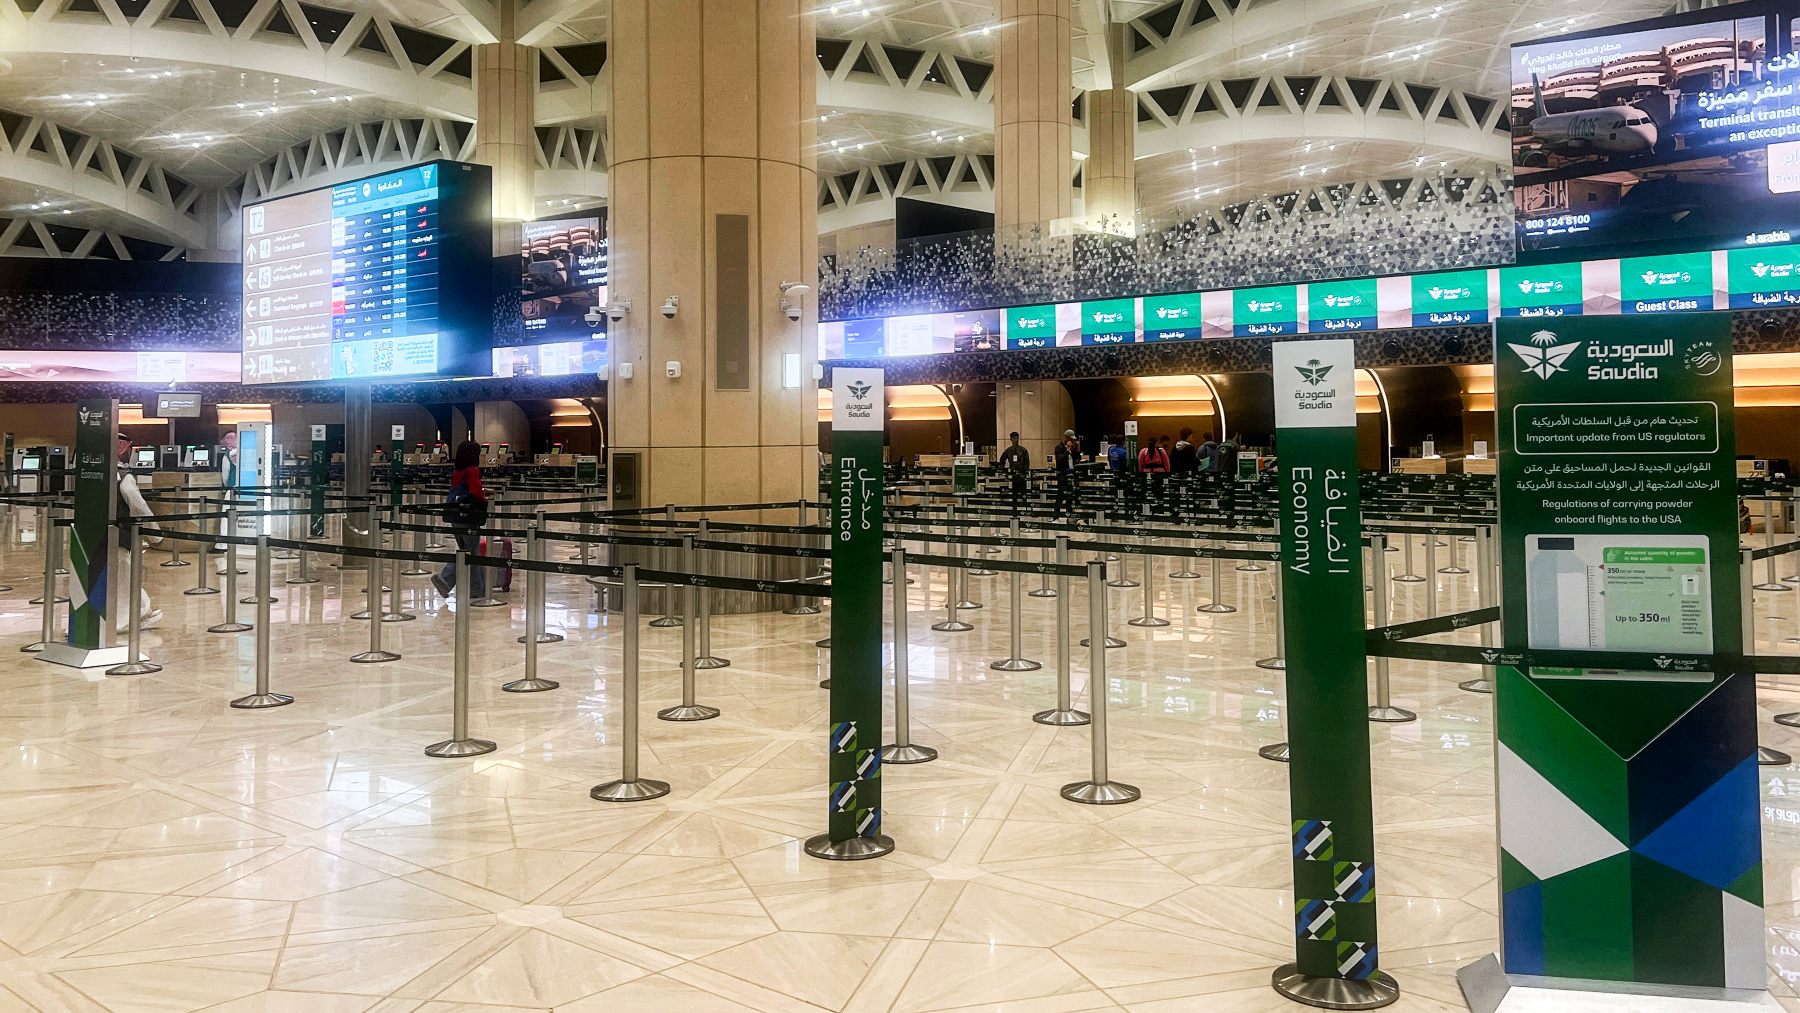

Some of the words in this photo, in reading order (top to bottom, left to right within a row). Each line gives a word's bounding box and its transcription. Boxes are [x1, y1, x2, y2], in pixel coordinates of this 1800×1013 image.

[1575, 46, 1599, 56] الملك
[1600, 43, 1621, 53] مطار
[1556, 50, 1574, 59] خالد
[1752, 80, 1793, 105] سفر
[1698, 90, 1749, 111] مميزة
[1698, 111, 1756, 129] Terminal
[1729, 131, 1746, 142] an
[251, 211, 263, 230] T2
[1525, 219, 1544, 229] 800
[1546, 216, 1564, 227] 124
[1565, 214, 1591, 225] 8100
[1745, 232, 1756, 245] al
[1757, 230, 1791, 244] arabia
[1635, 301, 1667, 312] Guest
[1668, 299, 1698, 310] Class
[1586, 338, 1674, 363] السعودية
[1587, 364, 1658, 381] Saudia
[1294, 388, 1336, 402] السعودية
[845, 402, 873, 411] السعودية
[1298, 400, 1333, 410] Saudia
[1531, 414, 1570, 428] الأمريكية
[1572, 416, 1612, 426] السلطات
[1614, 415, 1632, 427] قبل
[1633, 418, 1648, 427] من
[1649, 416, 1667, 428] هام
[1668, 415, 1699, 427] تحديث
[1526, 433, 1574, 443] Important
[1576, 432, 1610, 443] update
[1612, 432, 1636, 441] from
[1637, 432, 1652, 441] US
[1654, 432, 1706, 443] regulators
[1523, 464, 1543, 474] متن
[1544, 463, 1562, 474] على
[1562, 463, 1608, 474] المساحيق
[1609, 463, 1637, 474] لحمل
[1638, 462, 1672, 473] الجديدة
[1673, 462, 1711, 474] القوانين
[81, 468, 104, 480] Economy
[1516, 477, 1555, 491] الأمريكية
[1556, 480, 1593, 490] المتحدة
[1595, 480, 1628, 491] الولايات
[1629, 480, 1644, 492] إلى
[1646, 480, 1683, 492] المتجهة
[1685, 480, 1720, 491] الرحلات
[840, 457, 856, 542] Entrance
[858, 468, 877, 530] مدخل
[1542, 499, 1599, 510] Regulations
[1600, 498, 1610, 508] of
[1612, 499, 1654, 510] carrying
[1655, 499, 1693, 510] powder
[1290, 466, 1313, 575] Economy
[1320, 468, 1350, 574] الضيافة
[1554, 514, 1596, 524] onboard
[1597, 514, 1628, 525] flights
[1629, 515, 1639, 524] to
[1640, 514, 1658, 524] the
[1659, 514, 1682, 524] USA
[1615, 615, 1627, 623] Up
[1639, 613, 1660, 623] 350
